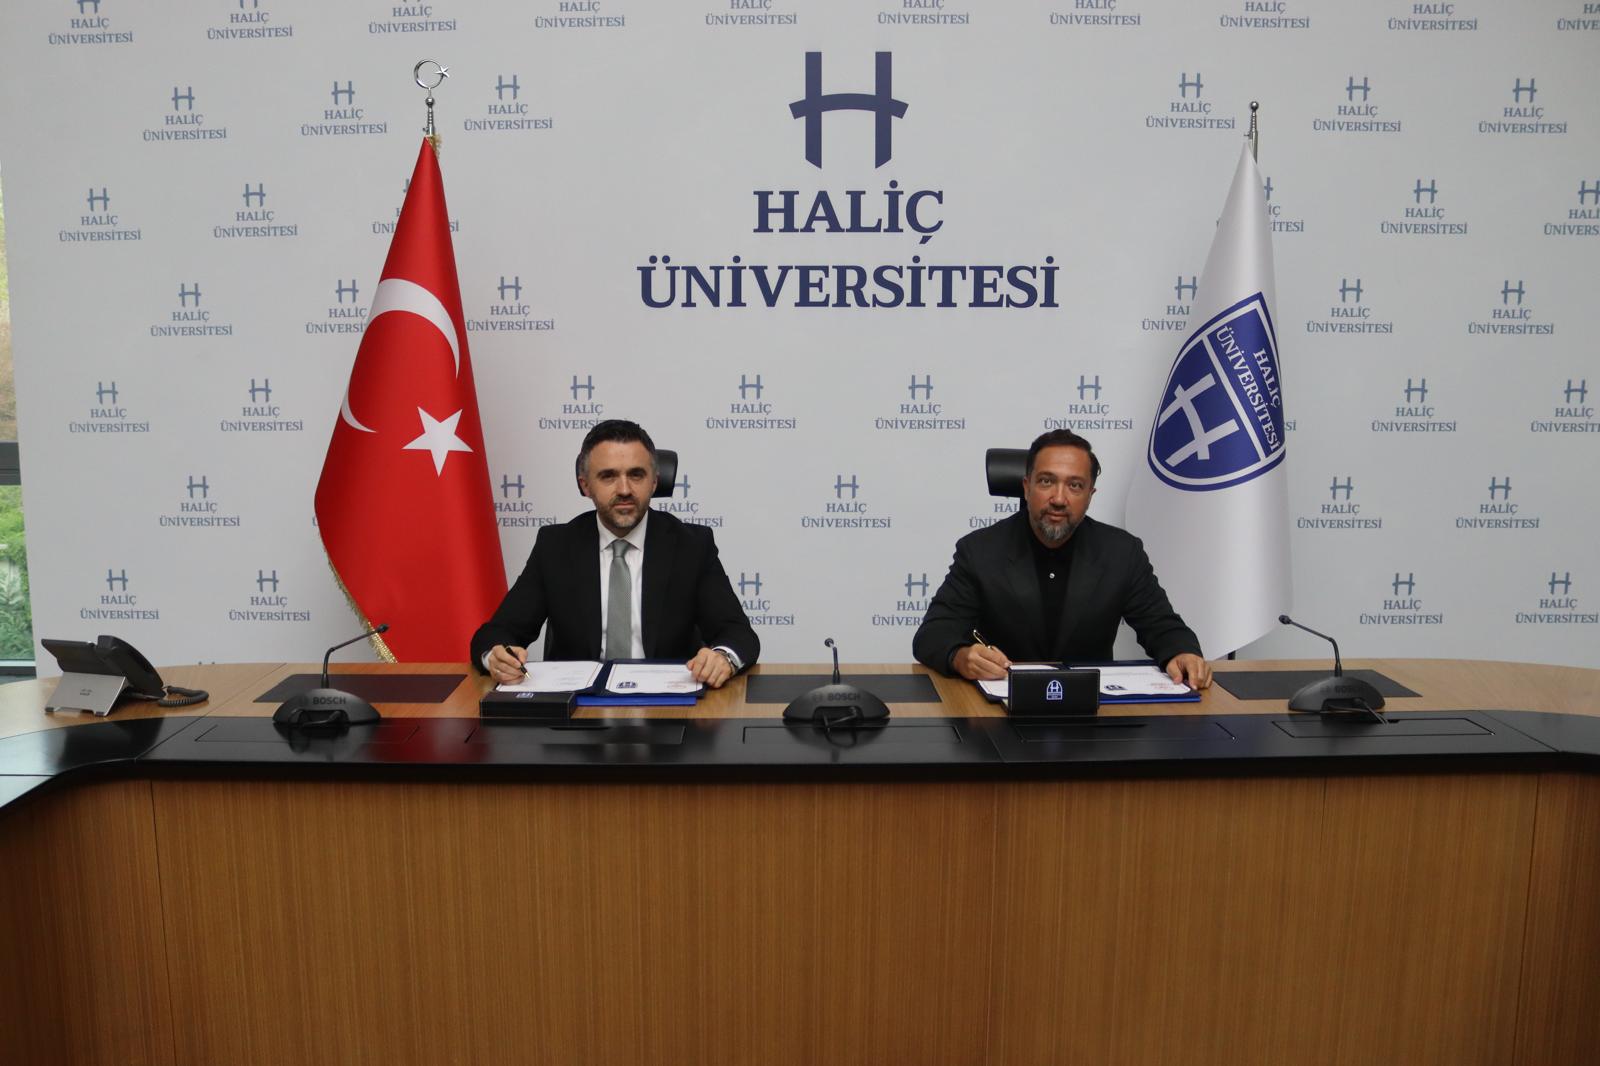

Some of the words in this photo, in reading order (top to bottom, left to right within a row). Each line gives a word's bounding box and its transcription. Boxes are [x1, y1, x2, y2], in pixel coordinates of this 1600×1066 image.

[392, 4, 432, 18] HALİÇ
[560, 0, 600, 14] HALİÇ
[1245, 0, 1286, 15] HALİÇ
[1413, 2, 1454, 16] HALİÇ
[70, 16, 109, 30] HALİÇ
[230, 11, 269, 24] HALİÇ
[535, 15, 625, 28] ÜNİVERSİTESİ
[705, 13, 797, 25] ÜNİVERSİTESİ
[877, 12, 969, 24] ÜNİVERSİTESİ
[1050, 12, 1141, 25] ÜNİVERSİTESİ
[1220, 14, 1310, 28] ÜNİVERSİTESİ
[1388, 17, 1478, 31] ÜNİVERSİTESİ
[206, 25, 292, 40] ÜNİVERSİTESİ
[368, 19, 456, 33] ÜNİVERSİTESİ
[48, 31, 133, 45] ÜNİVERSİTESİ
[324, 107, 363, 121] HALİÇ
[488, 102, 528, 116] HALİÇ
[1171, 100, 1211, 115] HALİÇ
[1338, 104, 1378, 118] HALİÇ
[1504, 105, 1544, 120] HALİÇ
[165, 113, 203, 126] HALİÇ
[464, 117, 552, 131] ÜNİVERSİTESİ
[1146, 115, 1235, 129] ÜNİVERSİTESİ
[1313, 119, 1401, 132] ÜNİVERSİTESİ
[143, 127, 227, 141] ÜNİVERSİTESİ
[301, 122, 387, 136] ÜNİVERSİTESİ
[1479, 121, 1568, 133] ÜNİVERSİTESİ
[236, 209, 274, 223] HALİÇ
[753, 180, 944, 244] HALİÇ
[1405, 206, 1445, 220] HALİÇ
[1568, 208, 1600, 219] HALİ
[81, 213, 118, 227] HALİÇ
[213, 224, 298, 238] ÜNİVERSİTESİ
[1381, 221, 1468, 235] ÜNİVERSİTESİ
[1543, 222, 1600, 235] ÜNİVERS
[59, 229, 141, 242] ÜNİVERSİTESİ
[636, 255, 1060, 309] ÜNİVERSİTESİ
[172, 309, 209, 323] HALİÇ
[490, 303, 530, 317] HALİÇ
[1331, 306, 1370, 319] HALİÇ
[1492, 307, 1532, 321] HALİÇ
[150, 324, 232, 336] ÜNİVERSİTESİ
[305, 321, 366, 334] ÜNİVERSİ
[1306, 320, 1393, 334] ÜNİVERSİTESİ
[1468, 322, 1554, 335] ÜNİVERSİTESİ
[1253, 349, 1281, 408] HALİÇ
[1216, 326, 1281, 451] ÜNİVERSİTESİ
[90, 406, 127, 420] HALİÇ
[242, 405, 280, 418] HALİÇ
[562, 402, 603, 416] HALİÇ
[731, 402, 772, 416] HALİÇ
[900, 402, 942, 416] HALİÇ
[1069, 403, 1109, 416] HALİÇ
[1395, 405, 1435, 419] HALİÇ
[1555, 405, 1594, 419] HALİÇ
[69, 421, 149, 433] ÜNİVERSİTESİ
[220, 419, 303, 432] ÜNİVERSİTESİ
[538, 416, 606, 429] ÜNİVERSİ
[705, 417, 797, 429] ÜNİVERSİTESİ
[874, 416, 965, 430] ÜNİVERSİTESİ
[1371, 420, 1457, 432] ÜNİVERSİTESİ
[180, 501, 218, 514] HALİÇ
[826, 501, 867, 515] HALİÇ
[1321, 502, 1360, 516] HALİÇ
[1480, 502, 1518, 516] HALİÇ
[159, 515, 240, 527] ÜNİVERSİTESİ
[801, 516, 891, 528] ÜNİVERSİTESİ
[1297, 517, 1382, 528] ÜNİVERSİTESİ
[1456, 517, 1540, 528] ÜNİVERSİTESİ
[101, 593, 136, 606] HALİÇ
[250, 595, 288, 609] HALİÇ
[741, 599, 771, 613] ALİÇ
[896, 599, 928, 611] HALİ
[1383, 597, 1422, 612] HALİÇ
[1539, 597, 1578, 611] HALİÇ
[80, 608, 159, 620] ÜNİVERSİTESİ
[229, 608, 310, 622] ÜNİVERSİTESİ
[1360, 613, 1443, 624] ÜNİVERSİTESİ
[1515, 612, 1599, 623] ÜNİVERSİTESİ
[312, 696, 346, 705] BOSCH
[828, 692, 861, 701] BOSCH
